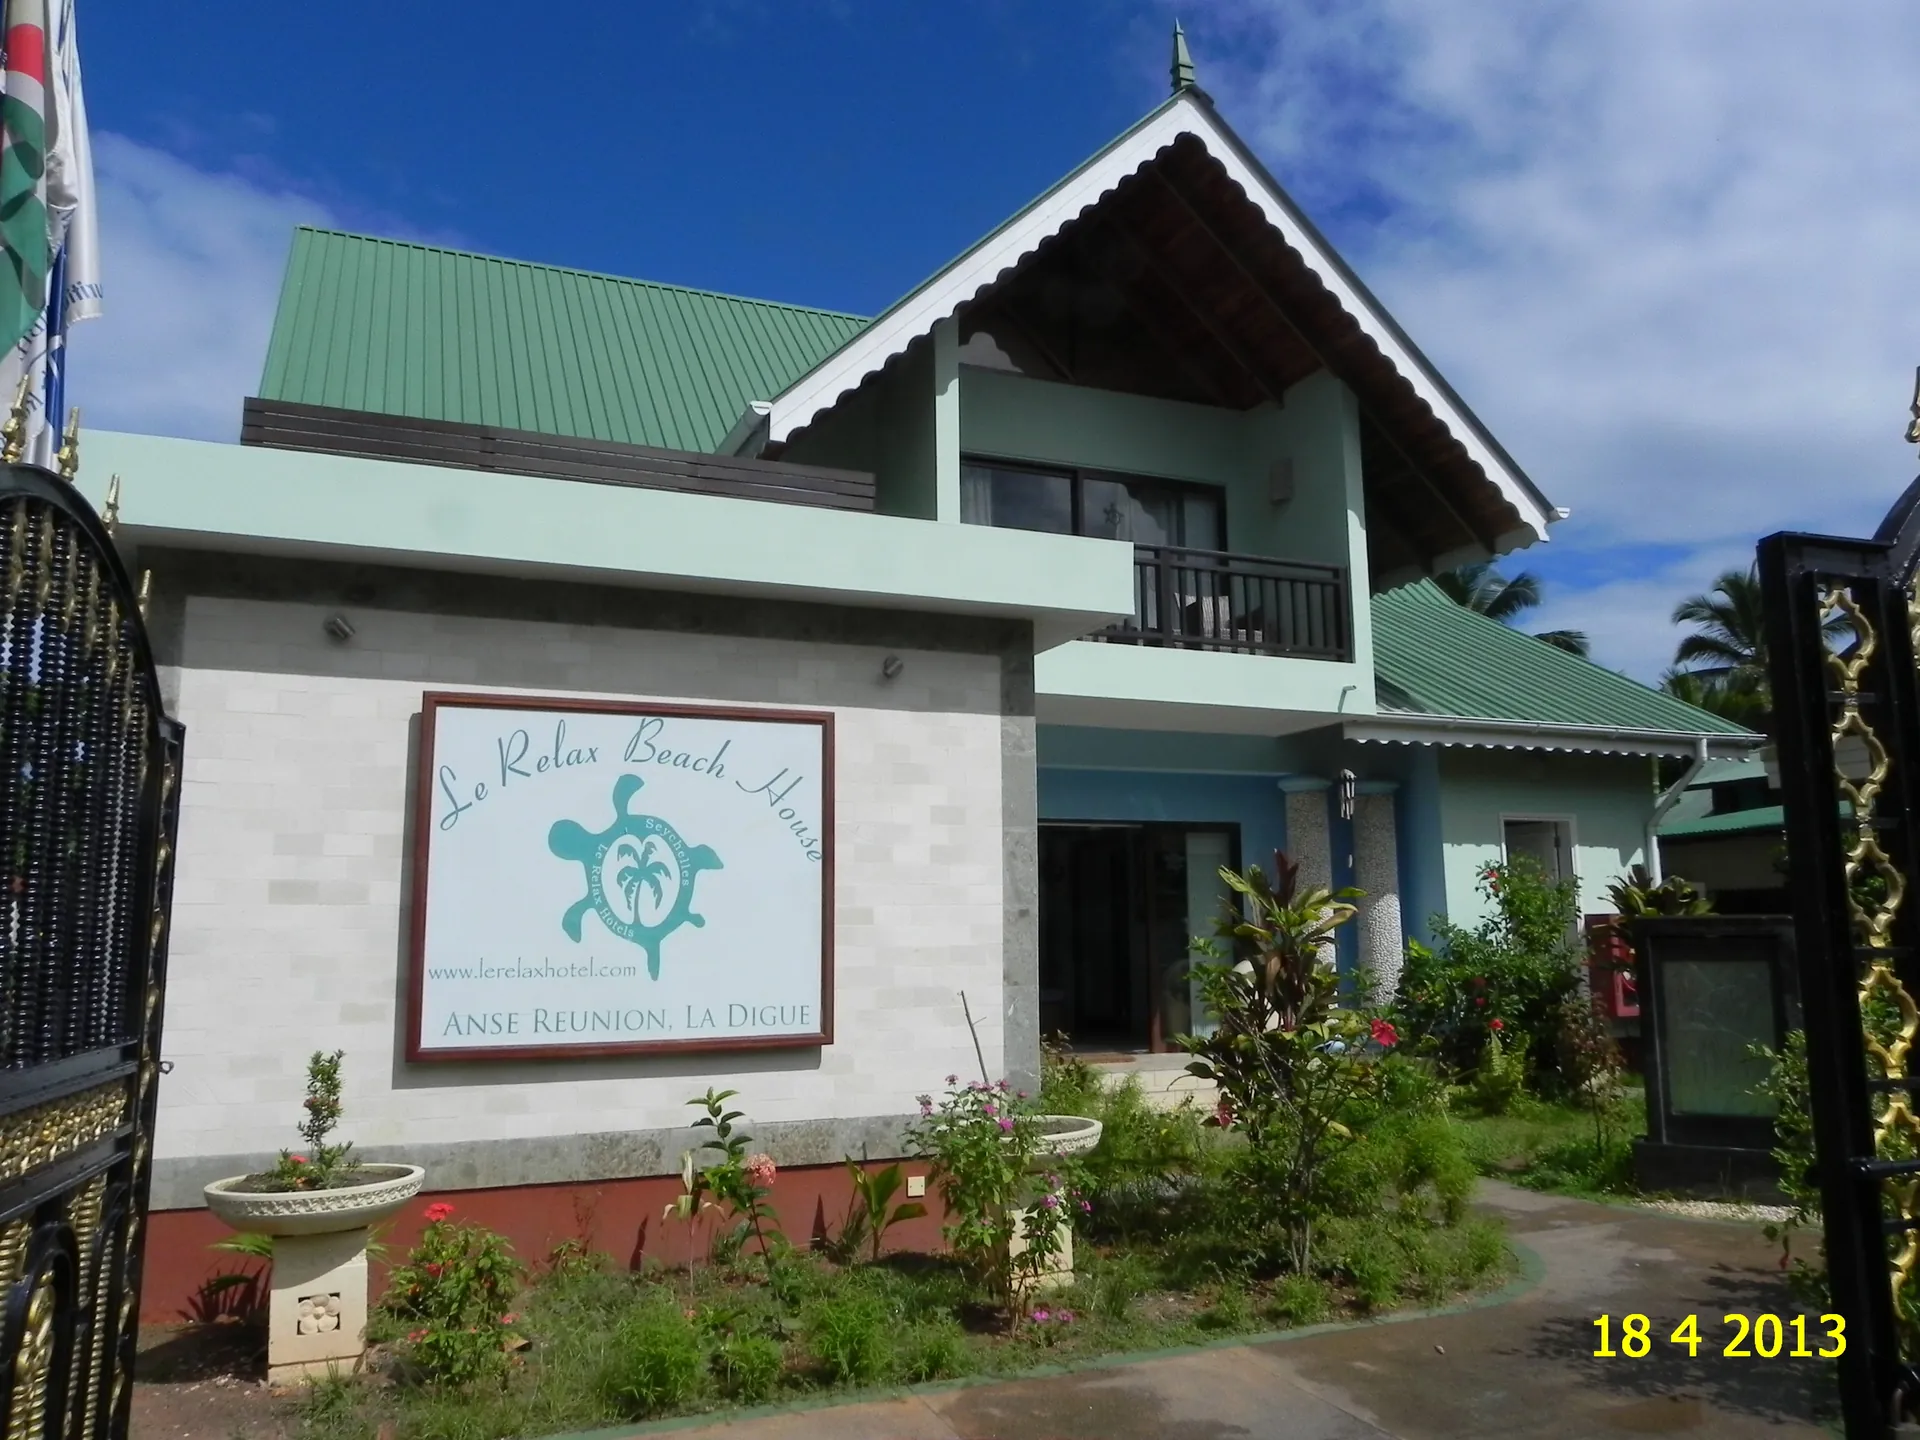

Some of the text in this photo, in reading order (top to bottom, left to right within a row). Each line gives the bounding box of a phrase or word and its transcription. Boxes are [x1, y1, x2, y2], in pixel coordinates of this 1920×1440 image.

[440, 717, 823, 863] Le Relax Beach House
[645, 818, 691, 887] Seychelles
[591, 843, 634, 938] Le Relax Hotels
[428, 957, 637, 980] www.lerelaxhotel.com
[442, 1003, 811, 1036] ANSE REUNION, LA DIGUE
